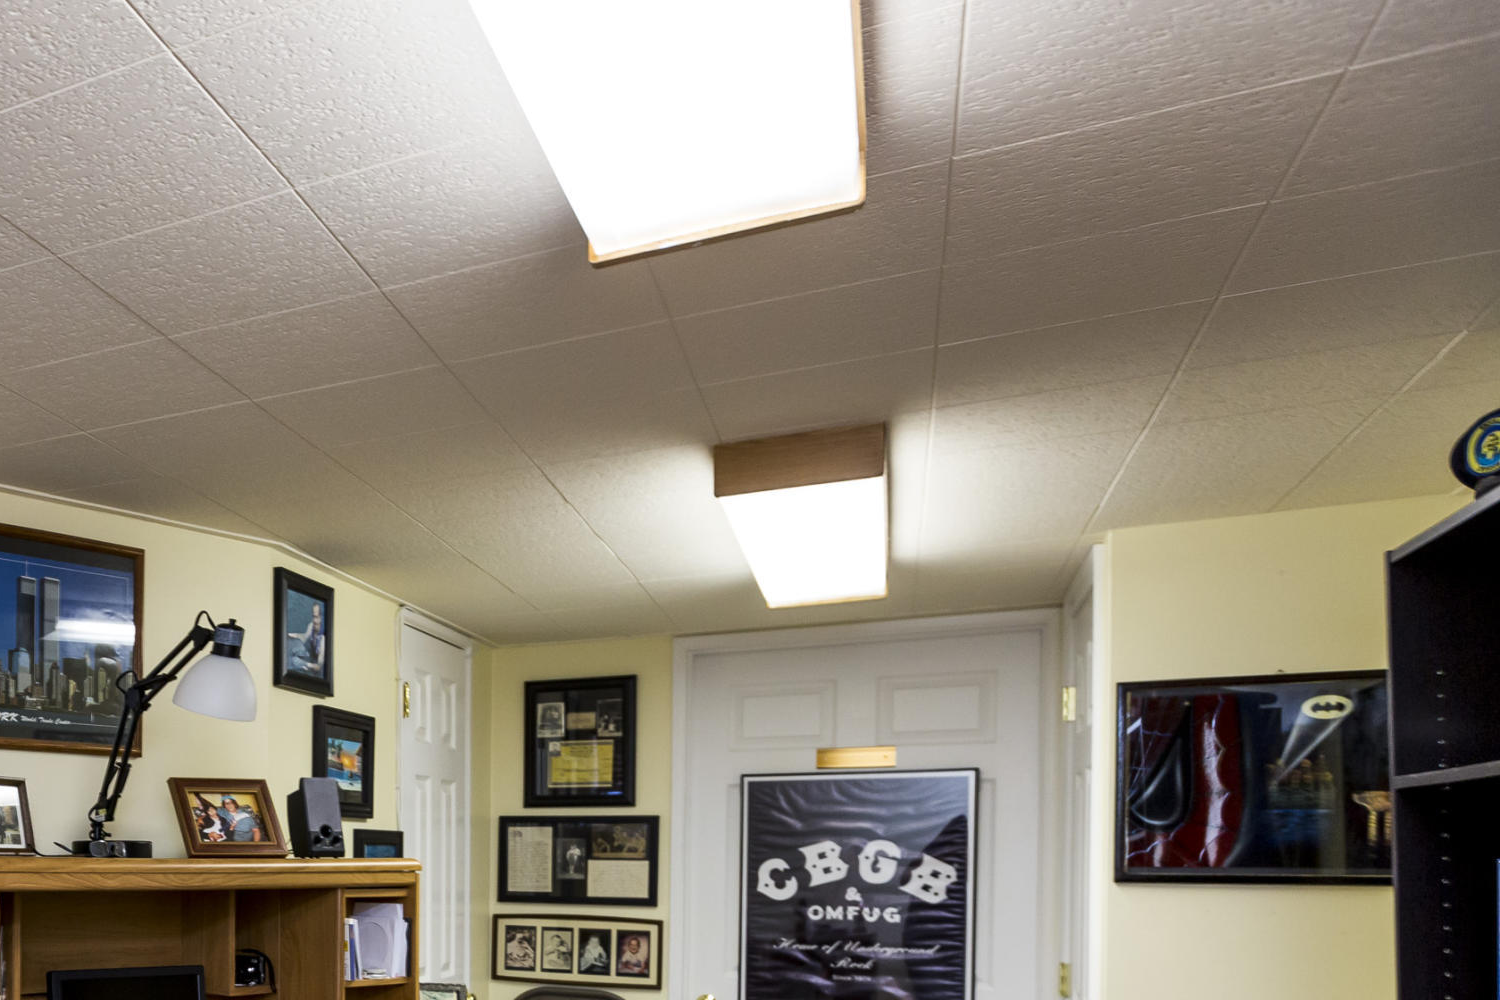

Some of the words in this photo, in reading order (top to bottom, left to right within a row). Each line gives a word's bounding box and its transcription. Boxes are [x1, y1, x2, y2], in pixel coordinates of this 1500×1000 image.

[757, 839, 958, 904] CBGB
[845, 886, 863, 902] &
[807, 904, 901, 924] OMFUG
[773, 937, 818, 950] Home
[821, 940, 842, 955] of
[844, 941, 941, 956] Underground
[830, 957, 876, 969] Rock
